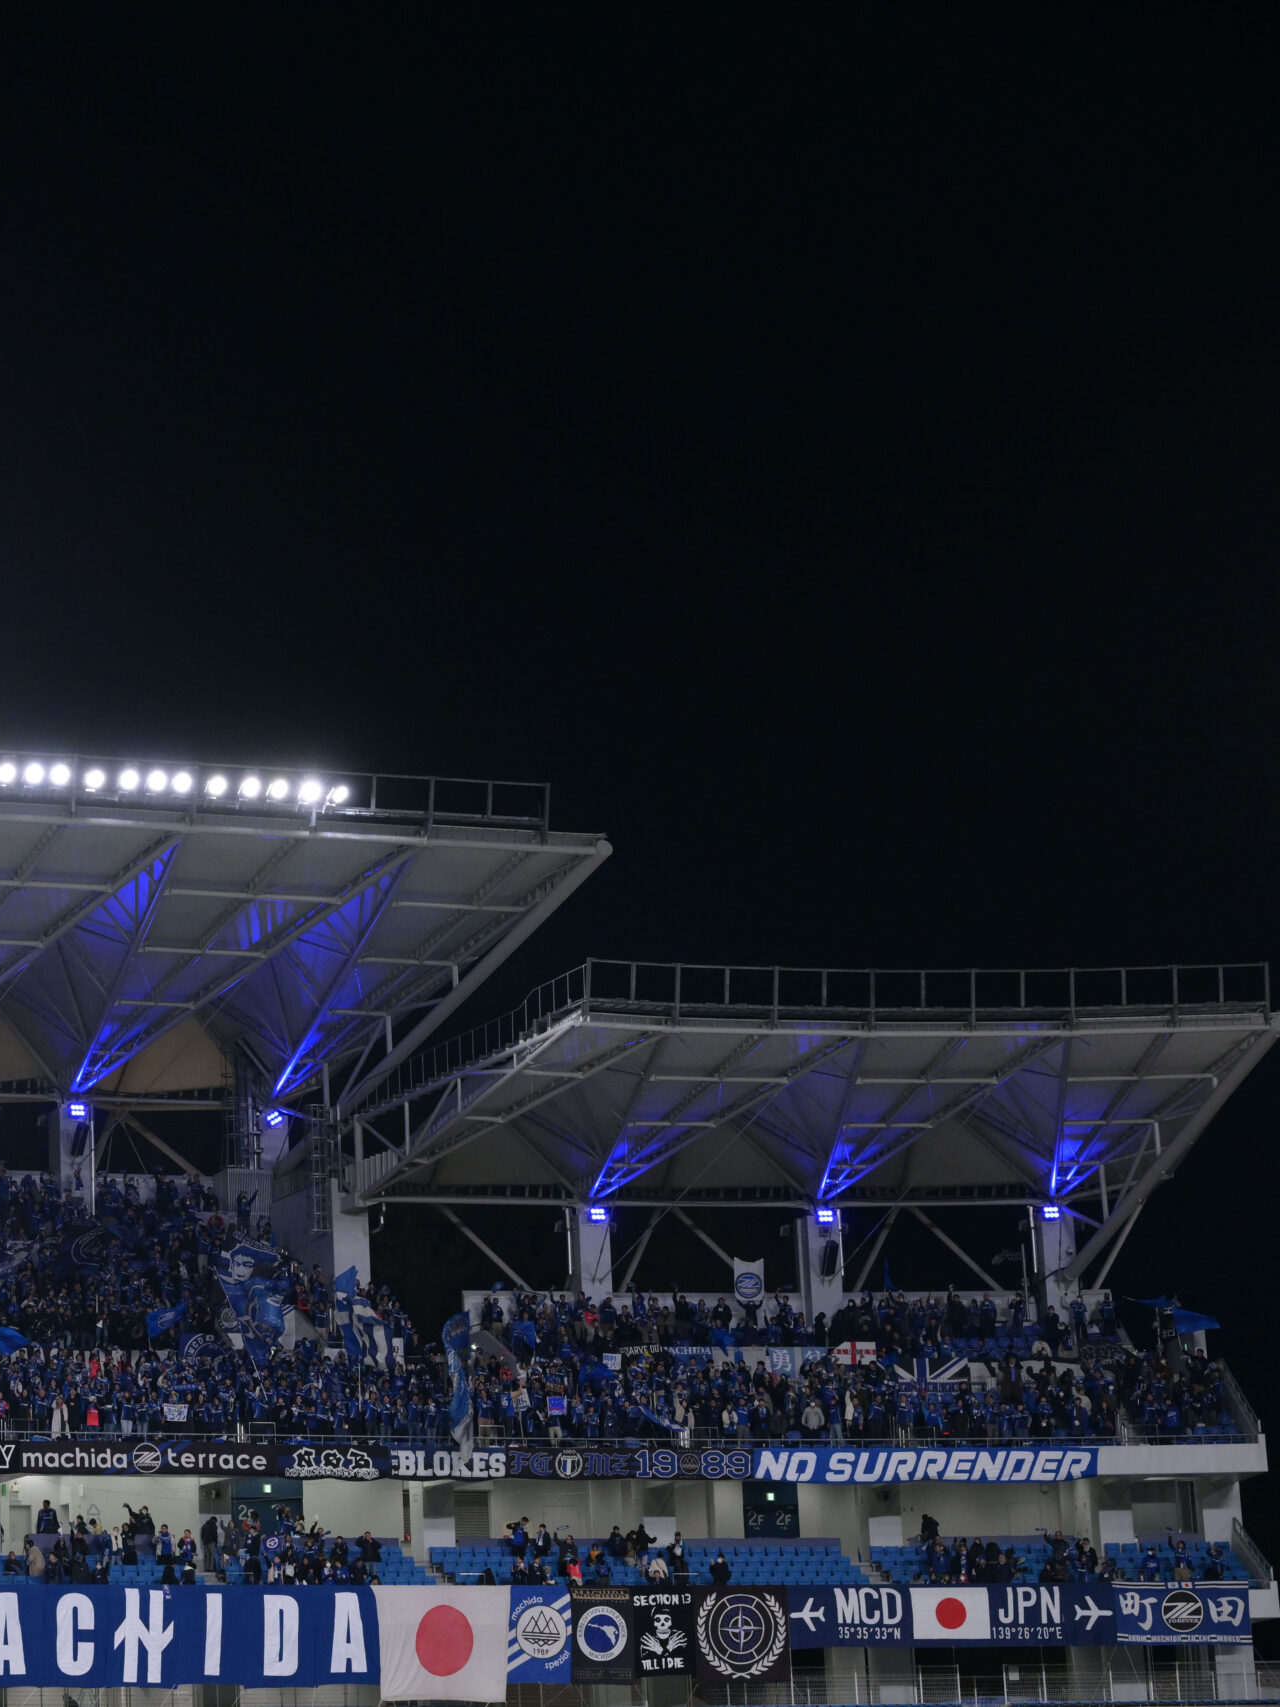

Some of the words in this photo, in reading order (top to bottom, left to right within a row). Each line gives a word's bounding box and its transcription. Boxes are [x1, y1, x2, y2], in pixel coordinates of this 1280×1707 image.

[22, 1448, 128, 1468] machida
[167, 1448, 267, 1471] terrace
[398, 1450, 506, 1478] BLOKES
[634, 1449, 678, 1478] 19
[701, 1450, 751, 1479] 89
[753, 1451, 817, 1482] NO
[825, 1451, 1092, 1482] SURRENDER
[747, 1510, 765, 1526] 2F
[775, 1510, 792, 1526] 2F
[511, 1595, 543, 1621] machida
[633, 1593, 680, 1607] SECTION
[681, 1593, 692, 1605] 13
[834, 1587, 903, 1625] MCD
[998, 1586, 1061, 1625] JPN
[1118, 1591, 1158, 1631] 町
[1207, 1596, 1245, 1627] 田
[1168, 1617, 1201, 1625] FOREVER
[532, 1647, 550, 1656] 1989
[641, 1658, 660, 1670] TILL
[667, 1657, 685, 1669] DIE
